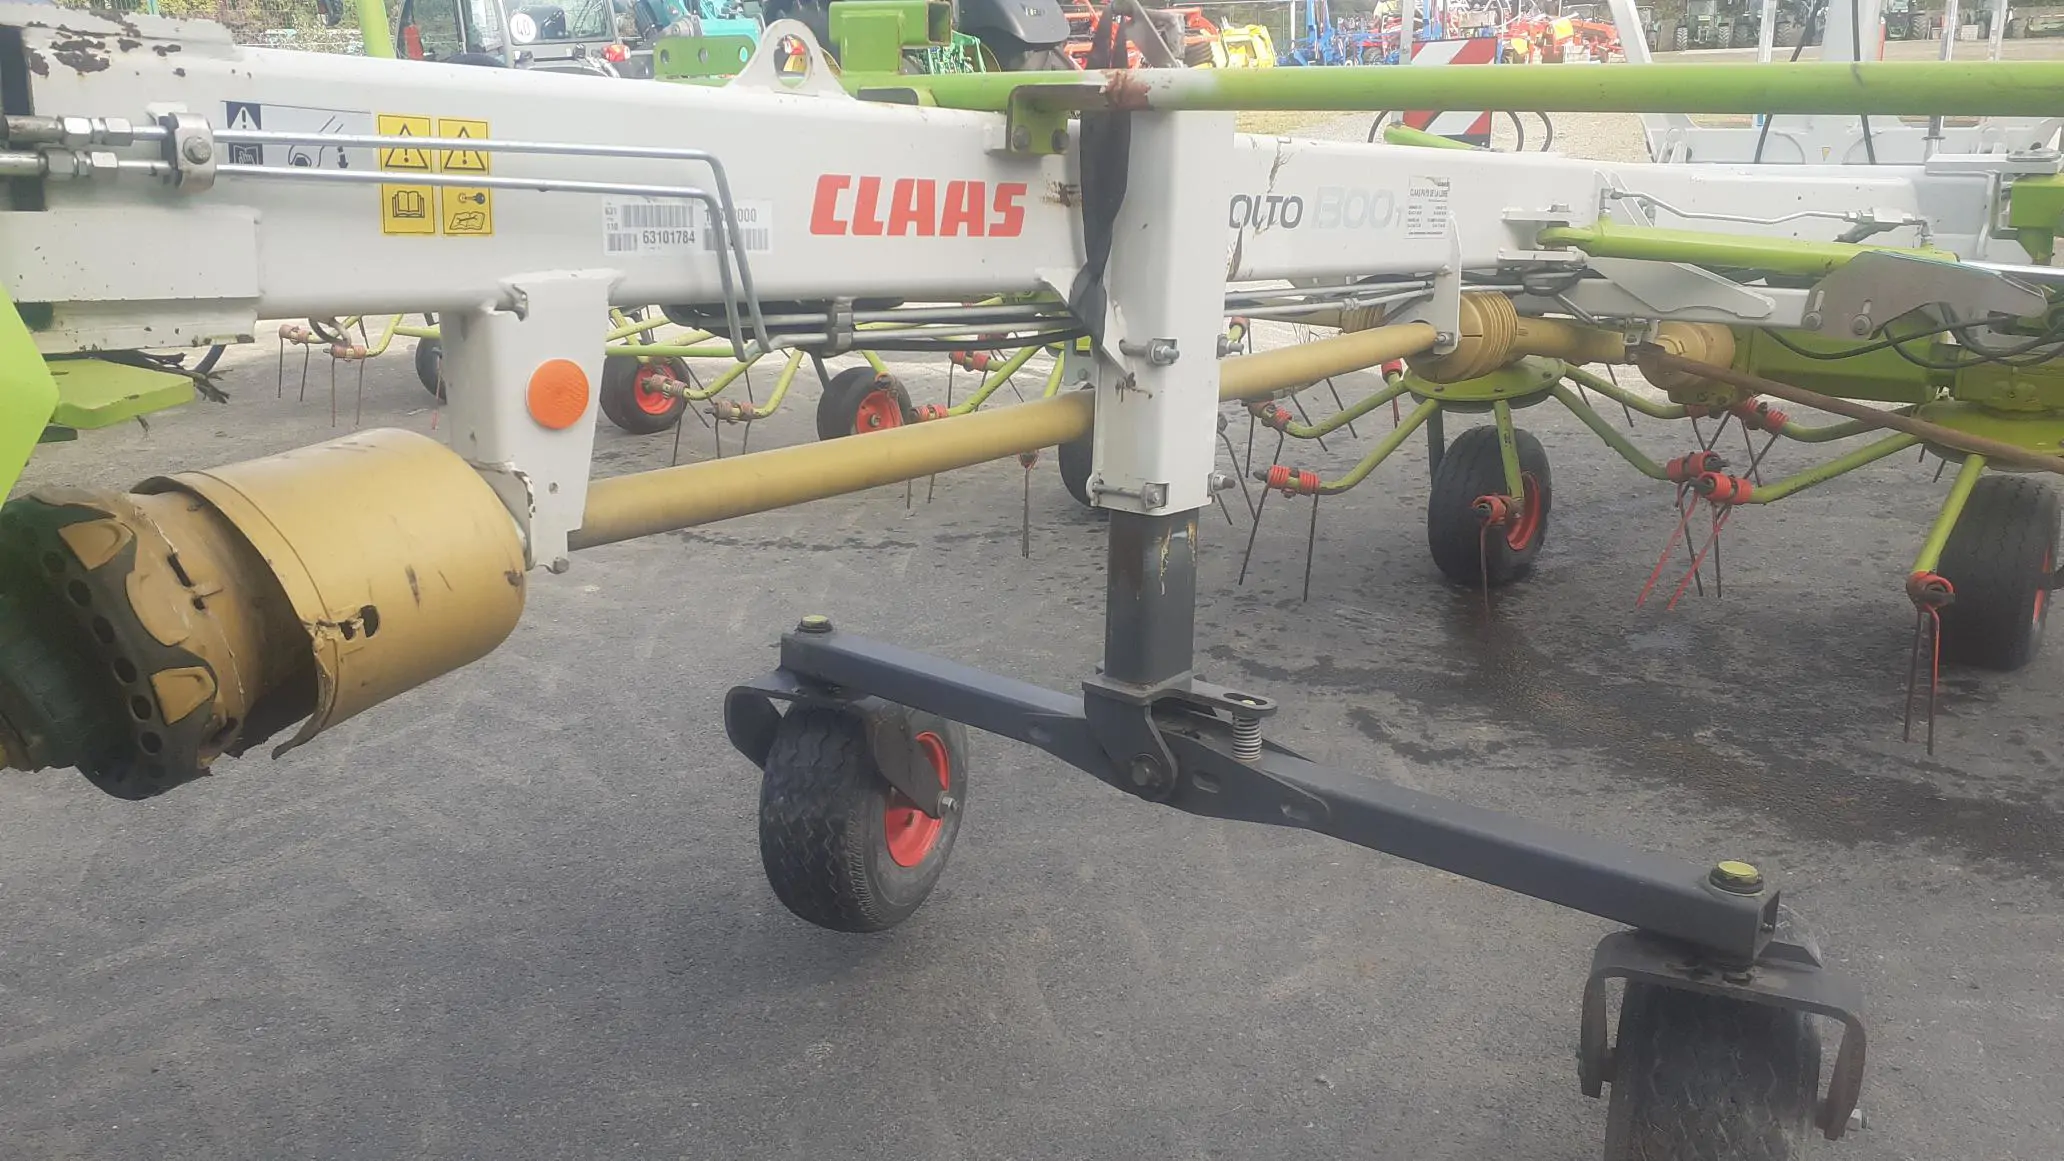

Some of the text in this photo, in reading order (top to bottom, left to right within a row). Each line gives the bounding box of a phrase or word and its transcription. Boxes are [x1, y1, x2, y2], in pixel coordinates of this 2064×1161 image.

[810, 174, 1027, 237] CLAAS
[1229, 194, 1304, 229] OLTO
[642, 230, 696, 244] 63101784
